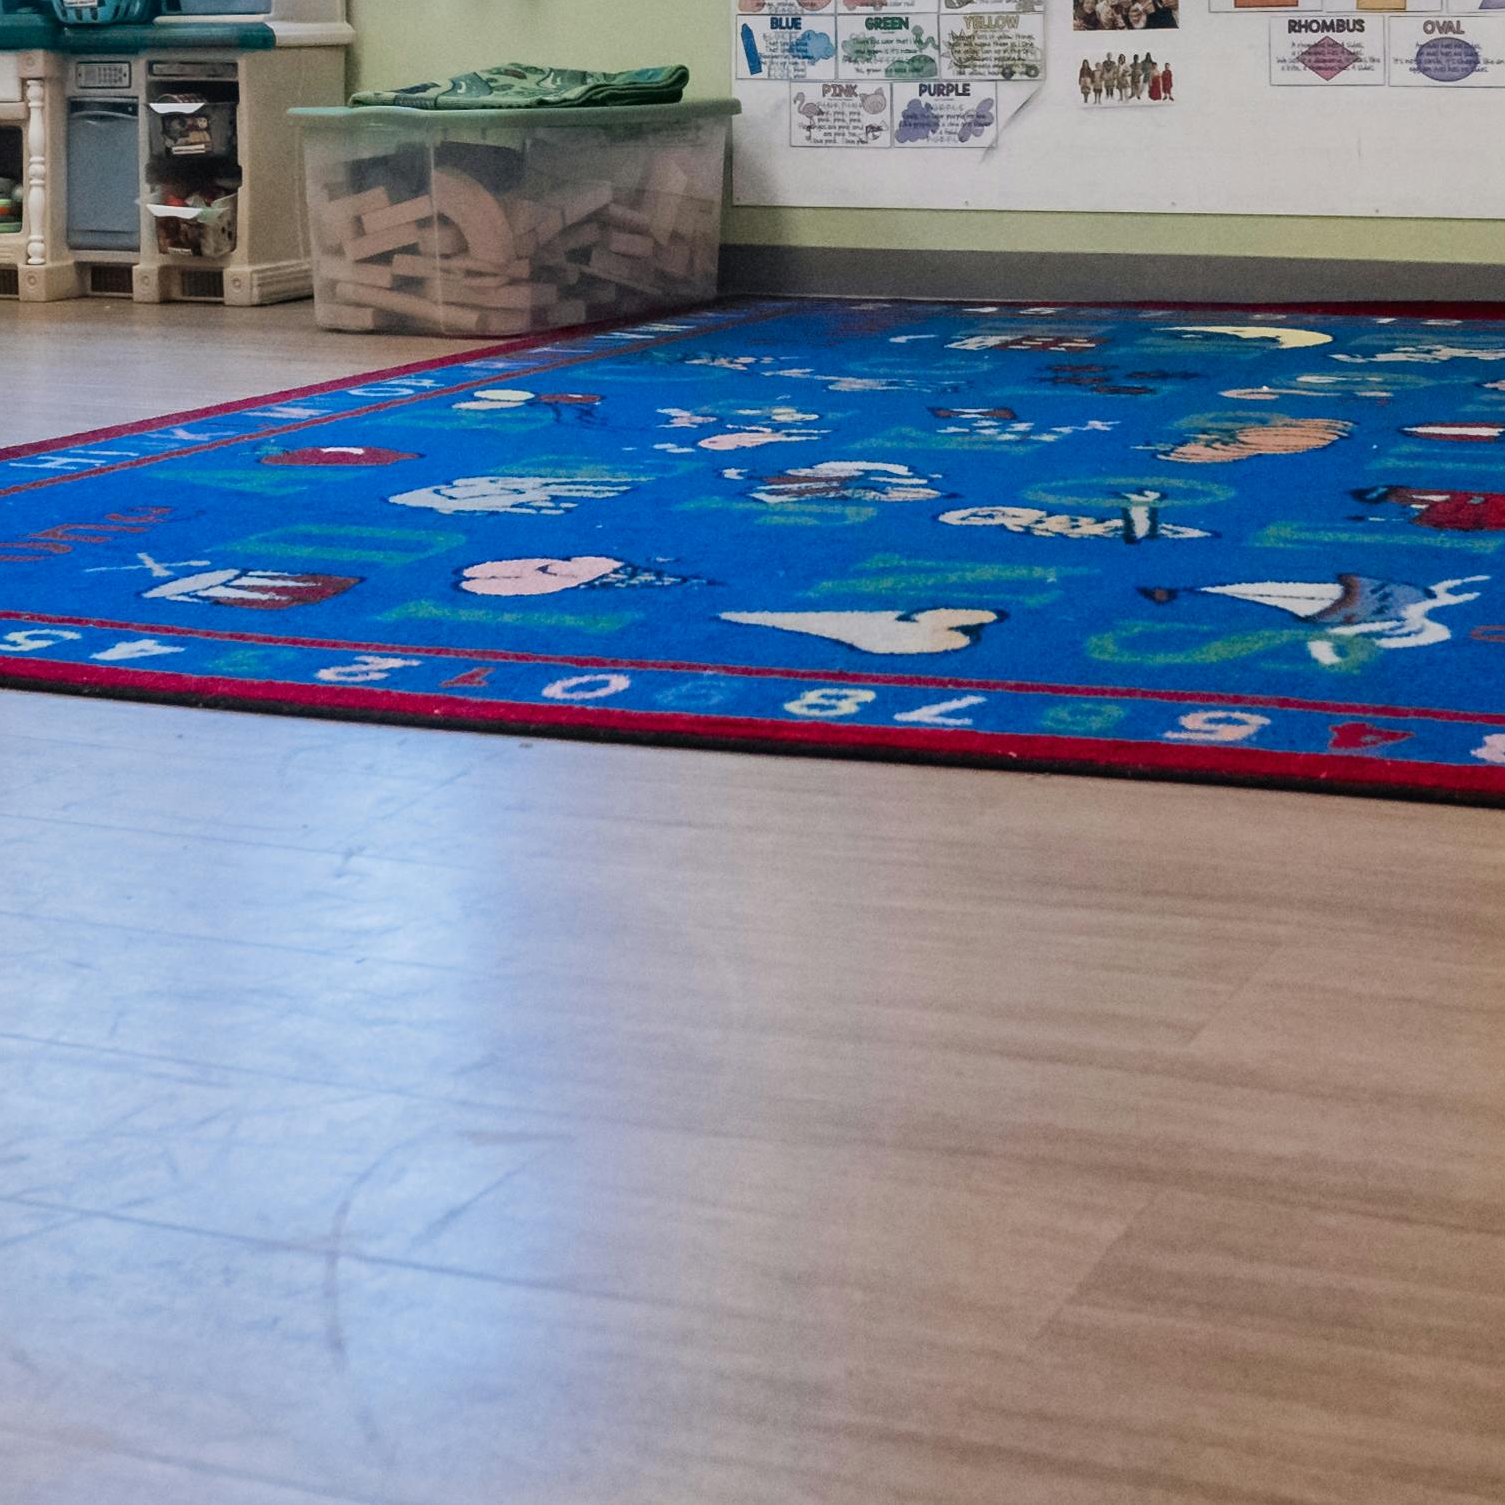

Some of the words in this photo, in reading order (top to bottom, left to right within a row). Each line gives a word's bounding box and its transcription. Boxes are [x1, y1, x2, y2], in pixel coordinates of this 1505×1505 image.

[770, 17, 802, 30] BLUE
[865, 17, 909, 30] GREEN
[963, 14, 1020, 29] YELLOW
[1288, 19, 1365, 34] RHOMBUS
[1423, 20, 1465, 35] OVAL
[822, 84, 858, 97] PINK
[919, 83, 971, 97] PURPLE
[784, 688, 876, 717] 8
[894, 695, 988, 725] 7
[1165, 711, 1273, 741] 5
